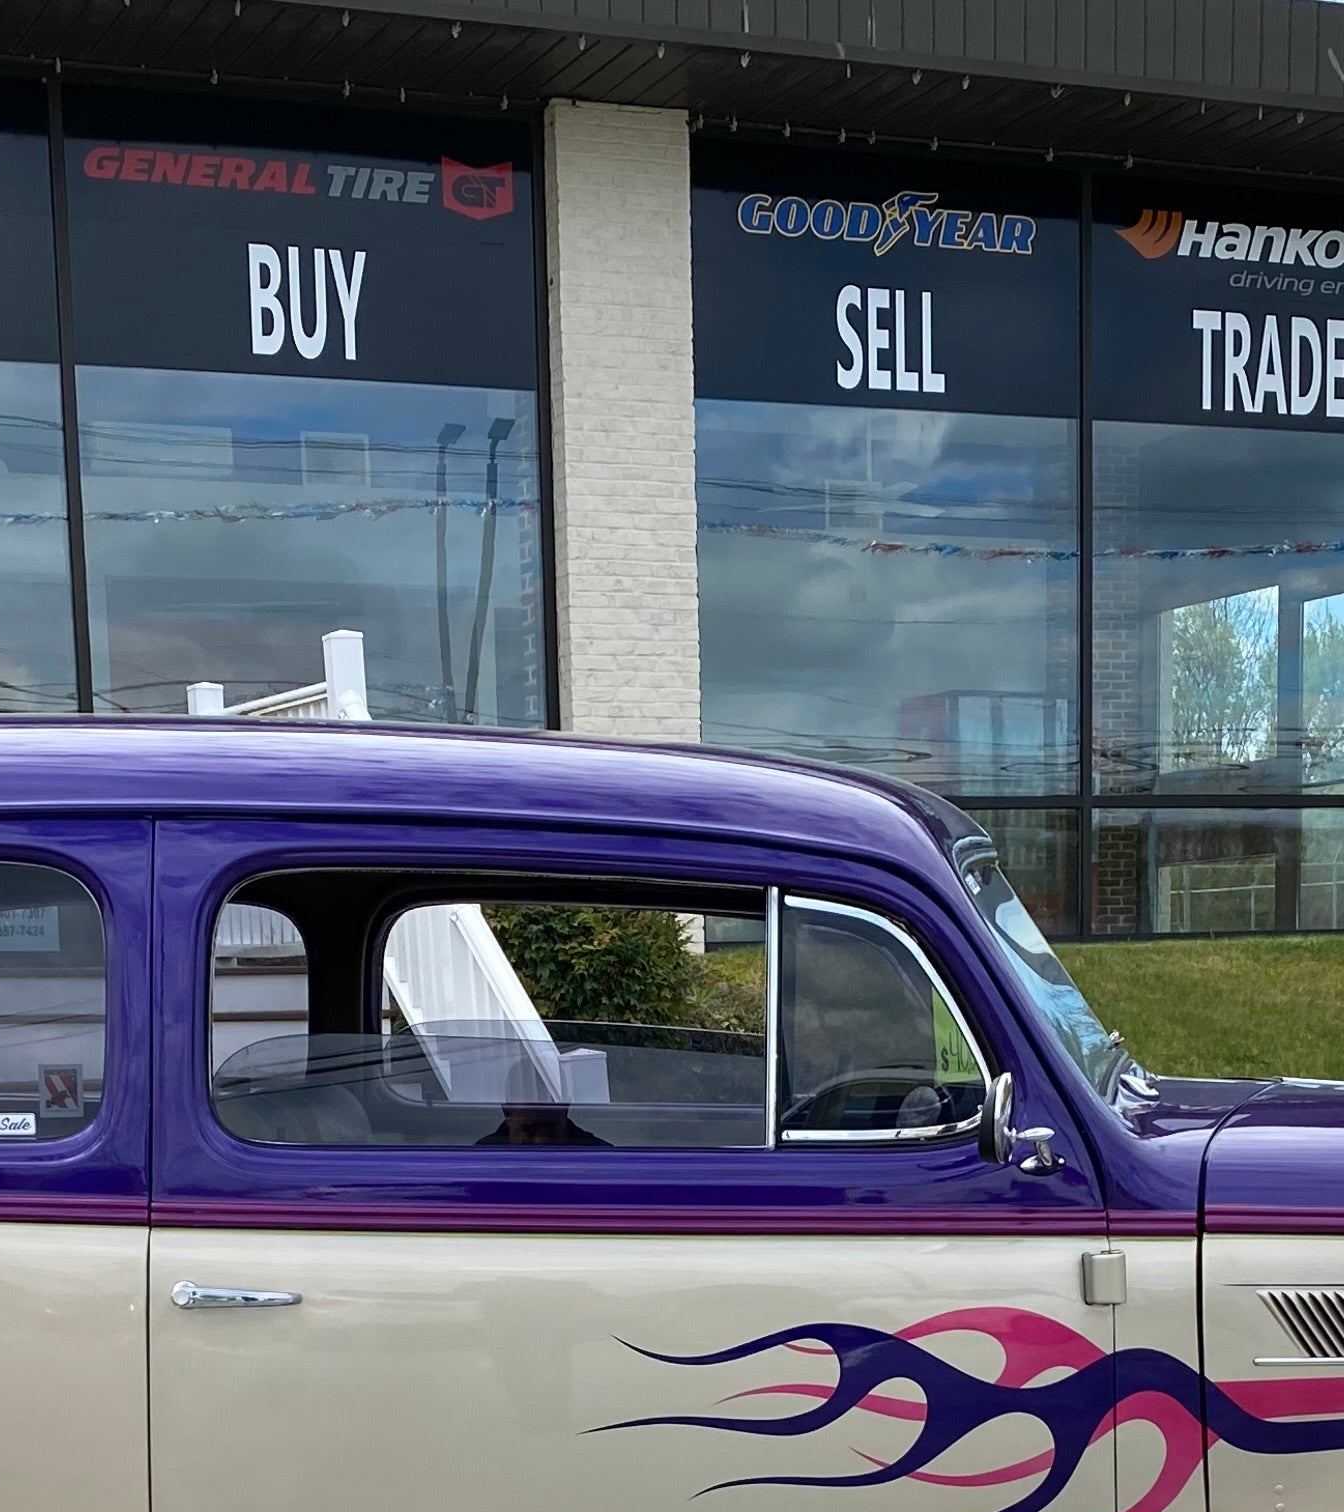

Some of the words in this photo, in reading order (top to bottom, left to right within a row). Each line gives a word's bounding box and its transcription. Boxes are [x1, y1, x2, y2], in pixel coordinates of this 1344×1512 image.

[83, 145, 317, 196] GENERAL
[326, 164, 436, 204] TIRE
[247, 242, 367, 361] BUY
[1229, 270, 1315, 296] driving
[836, 284, 946, 394] SELL
[0, 1117, 32, 1132] Sale
